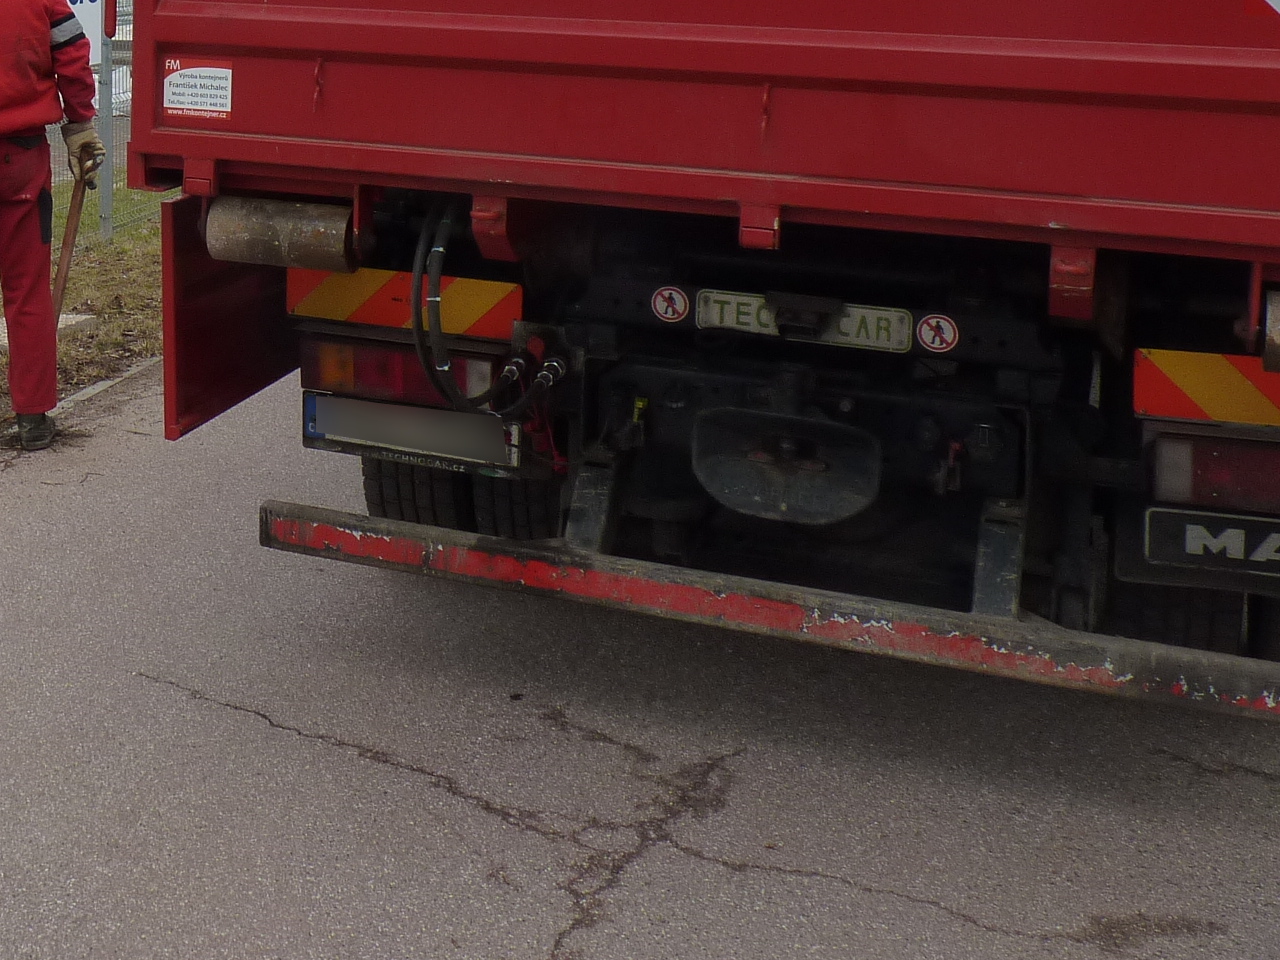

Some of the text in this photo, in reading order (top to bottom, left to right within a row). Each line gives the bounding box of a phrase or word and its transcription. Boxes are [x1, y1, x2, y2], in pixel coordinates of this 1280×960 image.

[165, 60, 180, 69] FM
[168, 80, 228, 92] František Michalec
[713, 298, 892, 343] TECCAR
[1184, 523, 1280, 562] MA
